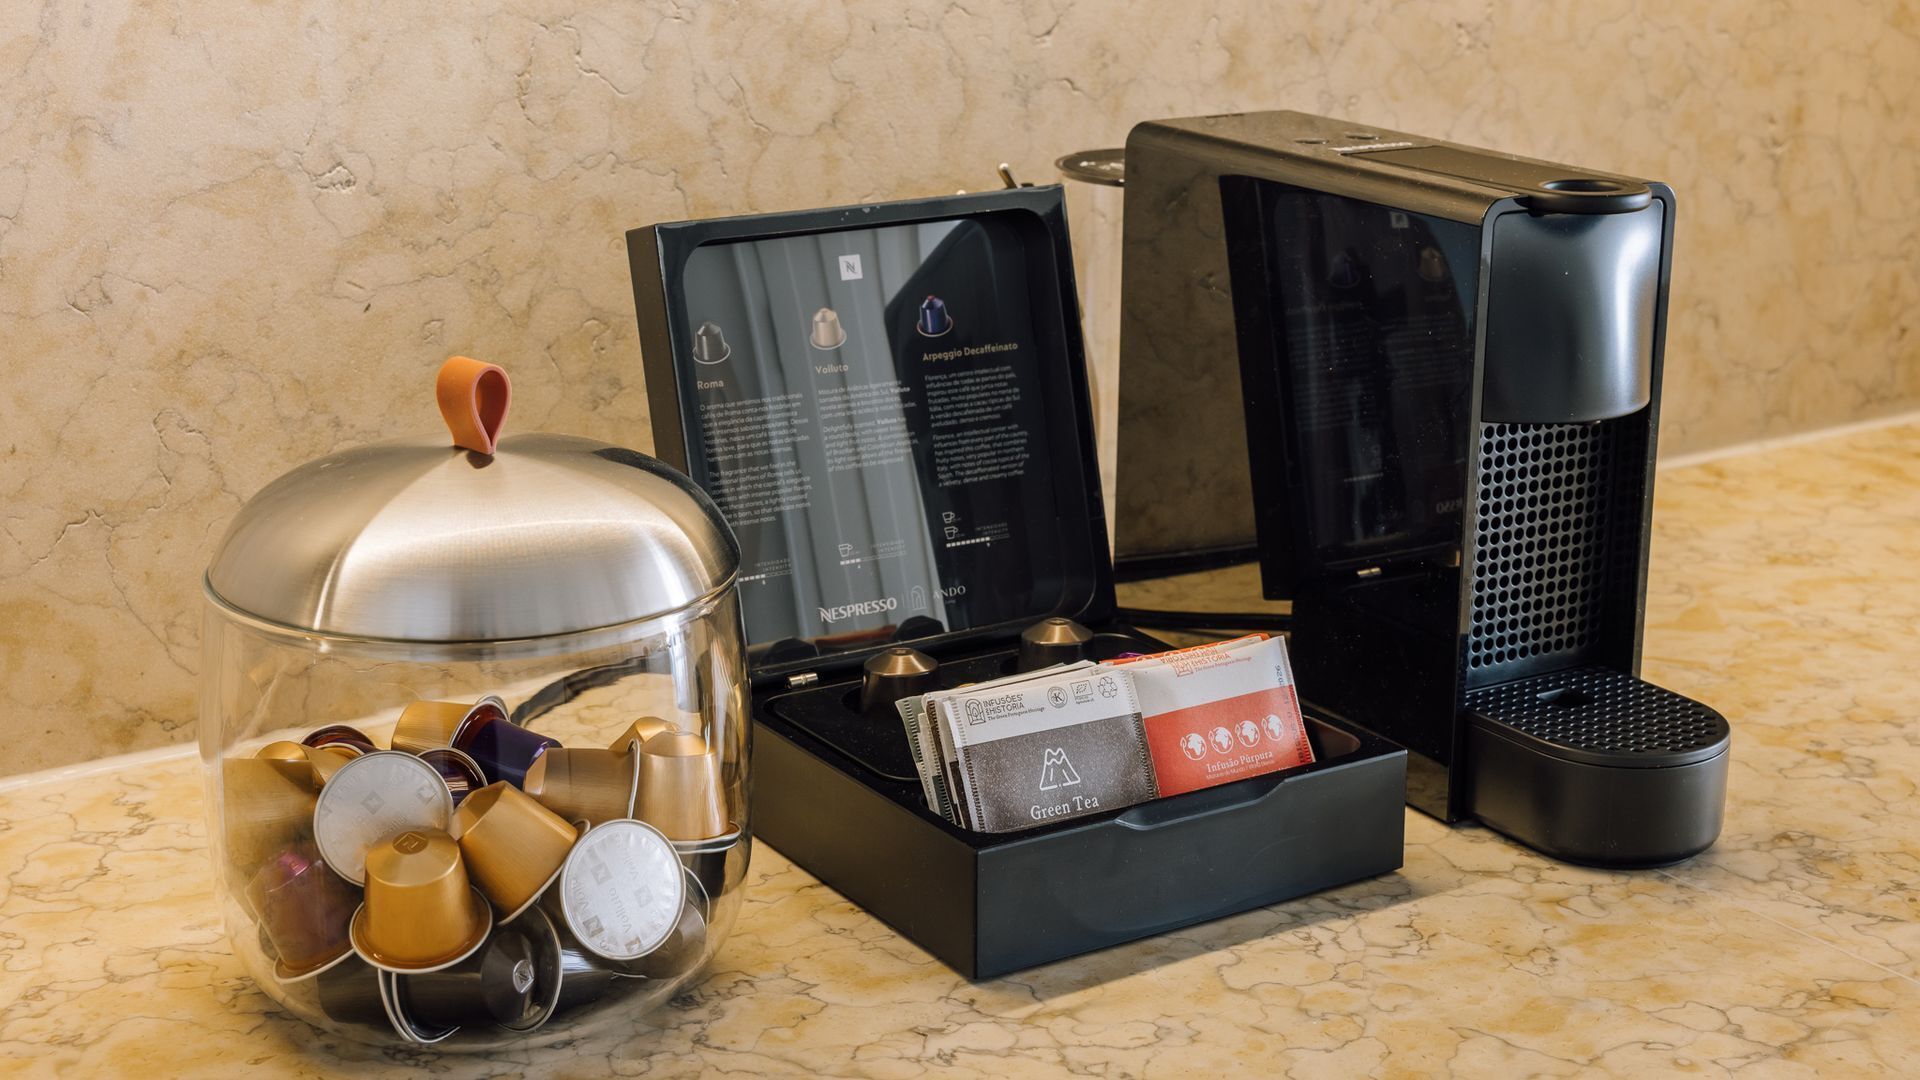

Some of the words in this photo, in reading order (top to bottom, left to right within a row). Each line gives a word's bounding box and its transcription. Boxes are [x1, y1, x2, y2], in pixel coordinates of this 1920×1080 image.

[922, 349, 963, 362] Arpeggio
[963, 343, 1018, 356] Decaffeinato
[815, 364, 849, 374] Volluto
[697, 380, 725, 391] Roma
[818, 598, 897, 623] NESPRESSO
[1206, 759, 1239, 773] Infusão
[1240, 751, 1273, 764] Púrpura
[1030, 803, 1071, 820] Green
[1073, 796, 1099, 811] Tea
